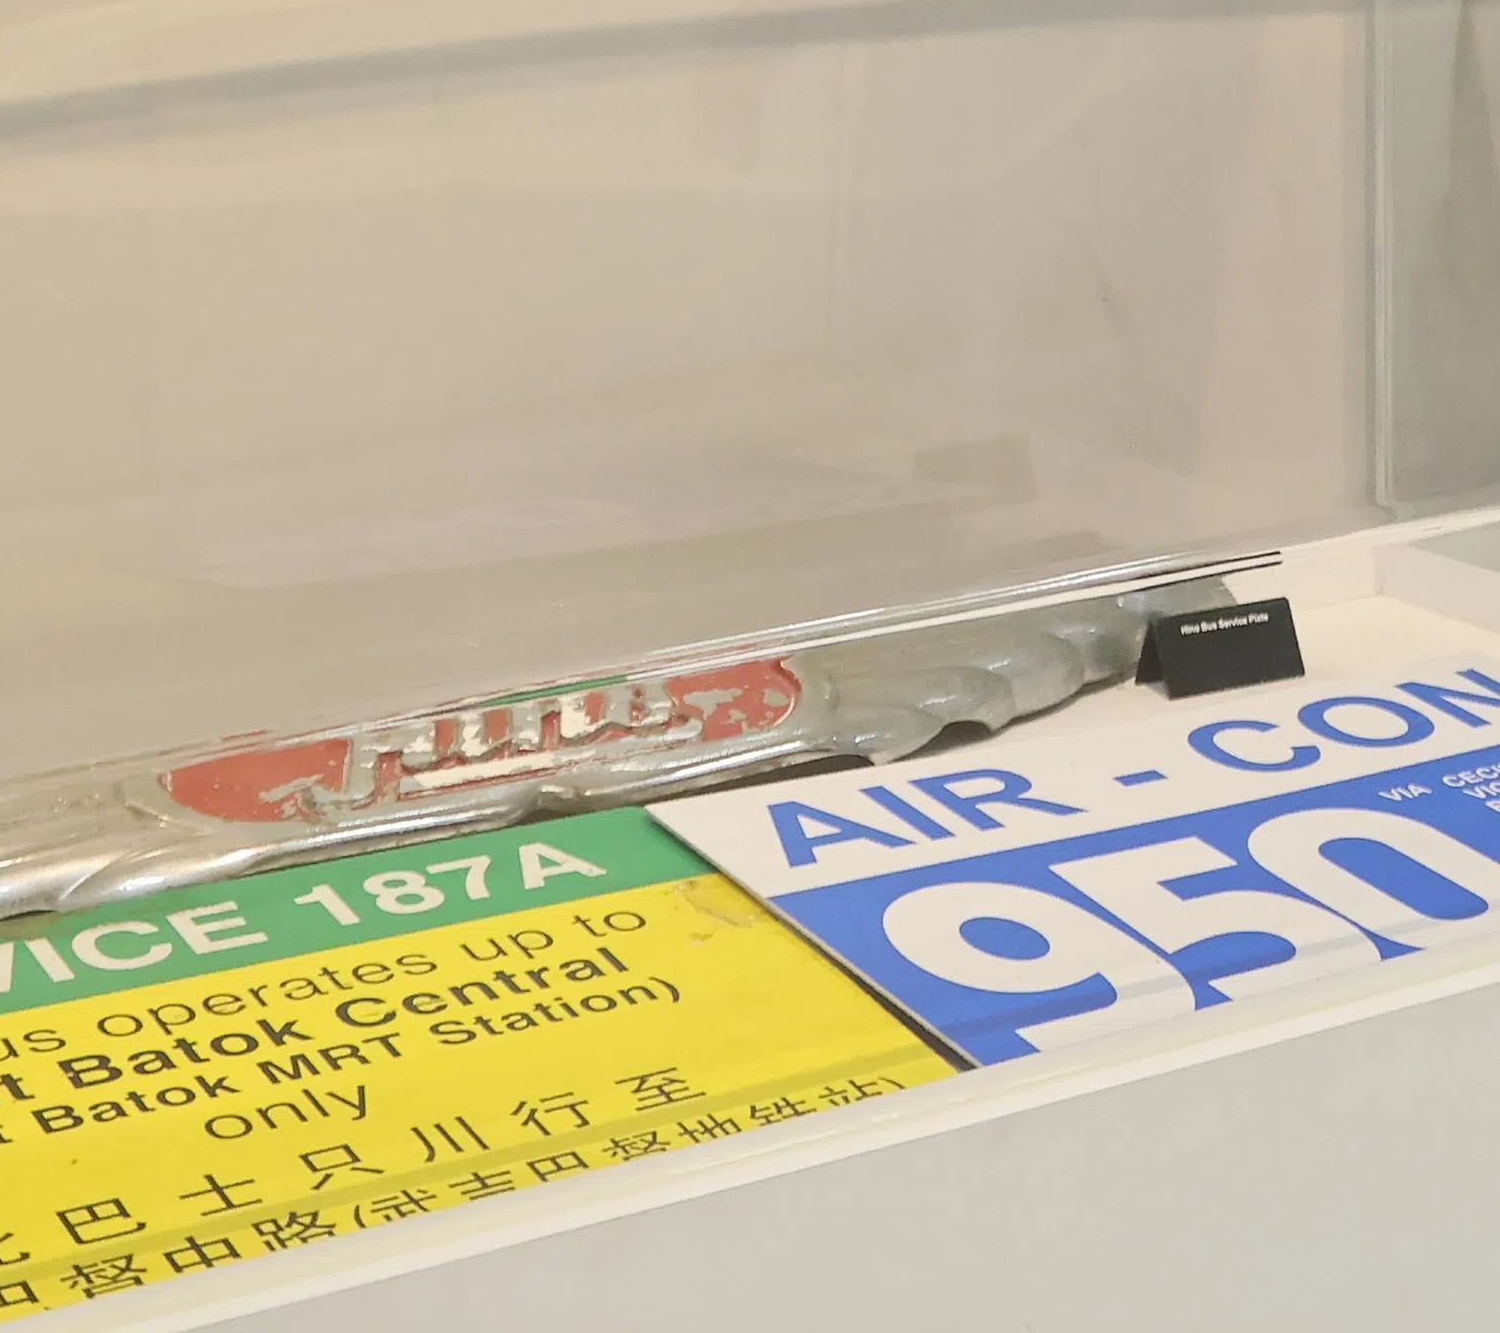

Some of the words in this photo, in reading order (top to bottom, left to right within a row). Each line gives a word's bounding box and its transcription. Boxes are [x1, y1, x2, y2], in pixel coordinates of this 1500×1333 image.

[1200, 621, 1218, 633] Bus
[1218, 616, 1248, 630] Service
[1248, 613, 1269, 624] Plate
[764, 769, 1083, 869] AIR
[1112, 767, 1171, 789] -
[1378, 782, 1434, 804] VIA
[293, 839, 608, 930] 187A
[56, 1007, 316, 1089] Batok
[333, 944, 631, 1028] Central
[96, 947, 438, 1037] operates
[460, 924, 555, 966] up
[571, 904, 647, 938] to
[36, 1069, 239, 1136] Batok
[262, 1032, 404, 1089] MRT
[436, 974, 682, 1049] Station)
[203, 1080, 369, 1143] only
